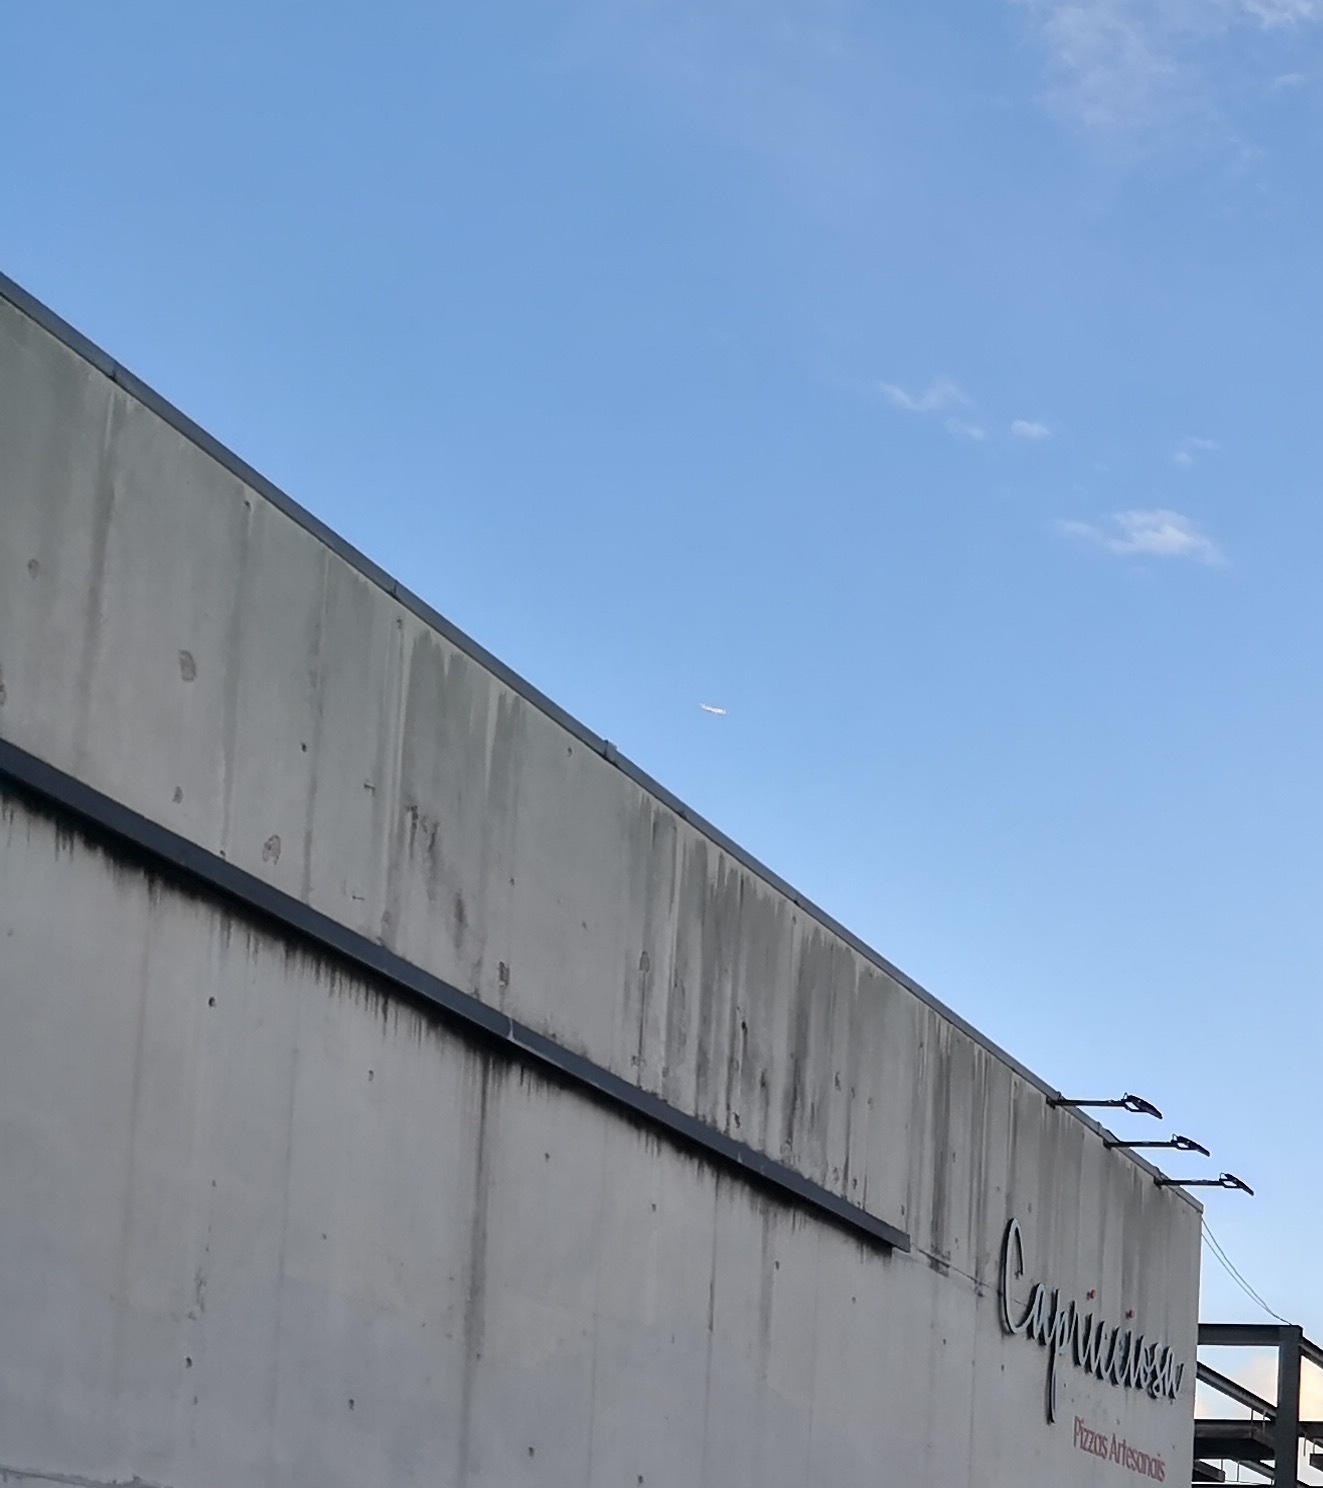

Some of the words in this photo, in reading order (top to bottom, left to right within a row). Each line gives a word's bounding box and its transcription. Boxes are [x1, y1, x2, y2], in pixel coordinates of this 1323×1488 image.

[1000, 1217, 1185, 1424] Capricciosa
[1074, 1415, 1108, 1460] Pizzas
[1109, 1433, 1165, 1483] Artesanais
